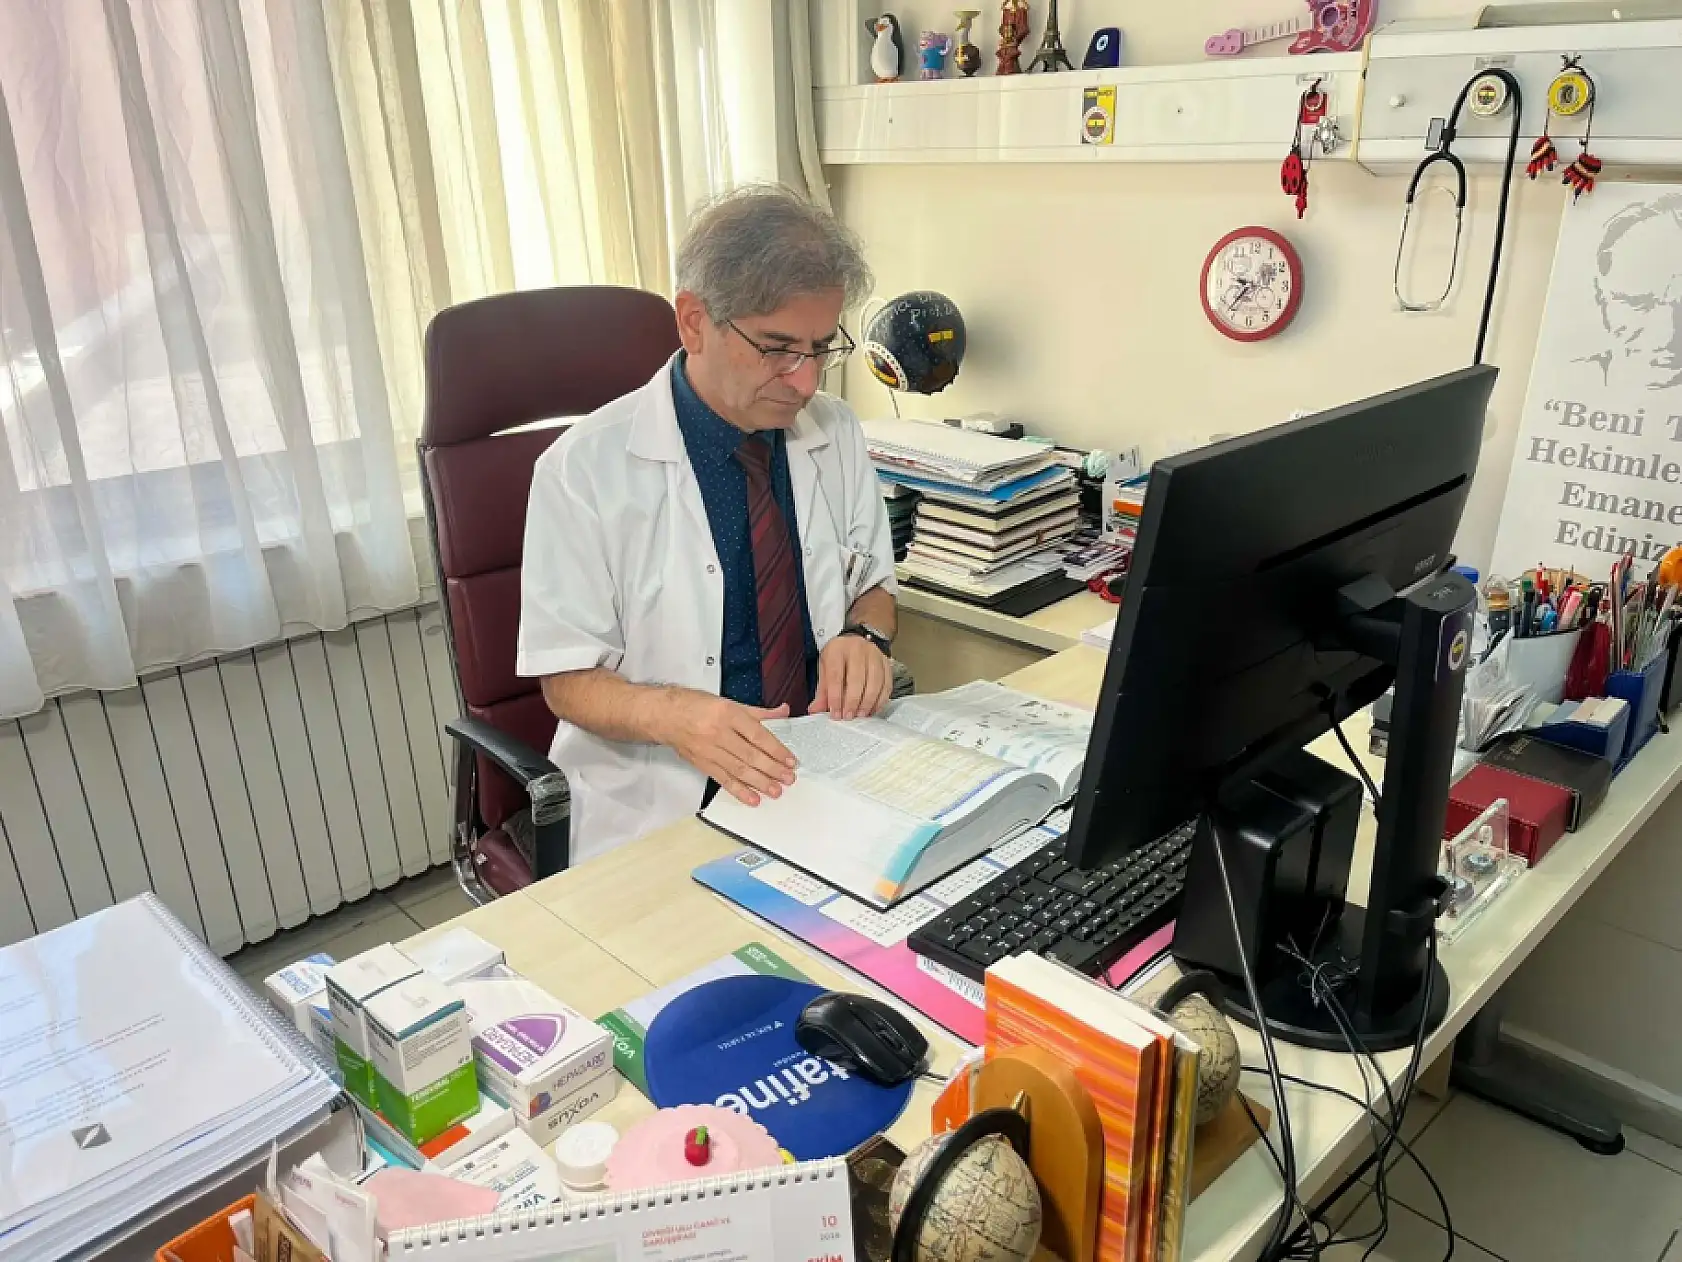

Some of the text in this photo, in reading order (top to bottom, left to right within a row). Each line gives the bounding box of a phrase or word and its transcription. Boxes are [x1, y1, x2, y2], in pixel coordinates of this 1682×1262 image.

[1544, 399, 1645, 436] “Beni
[1526, 436, 1682, 484] Hekimle
[1558, 481, 1682, 525] Emane
[715, 1056, 851, 1117] tafine
[821, 1215, 838, 1229] 10
